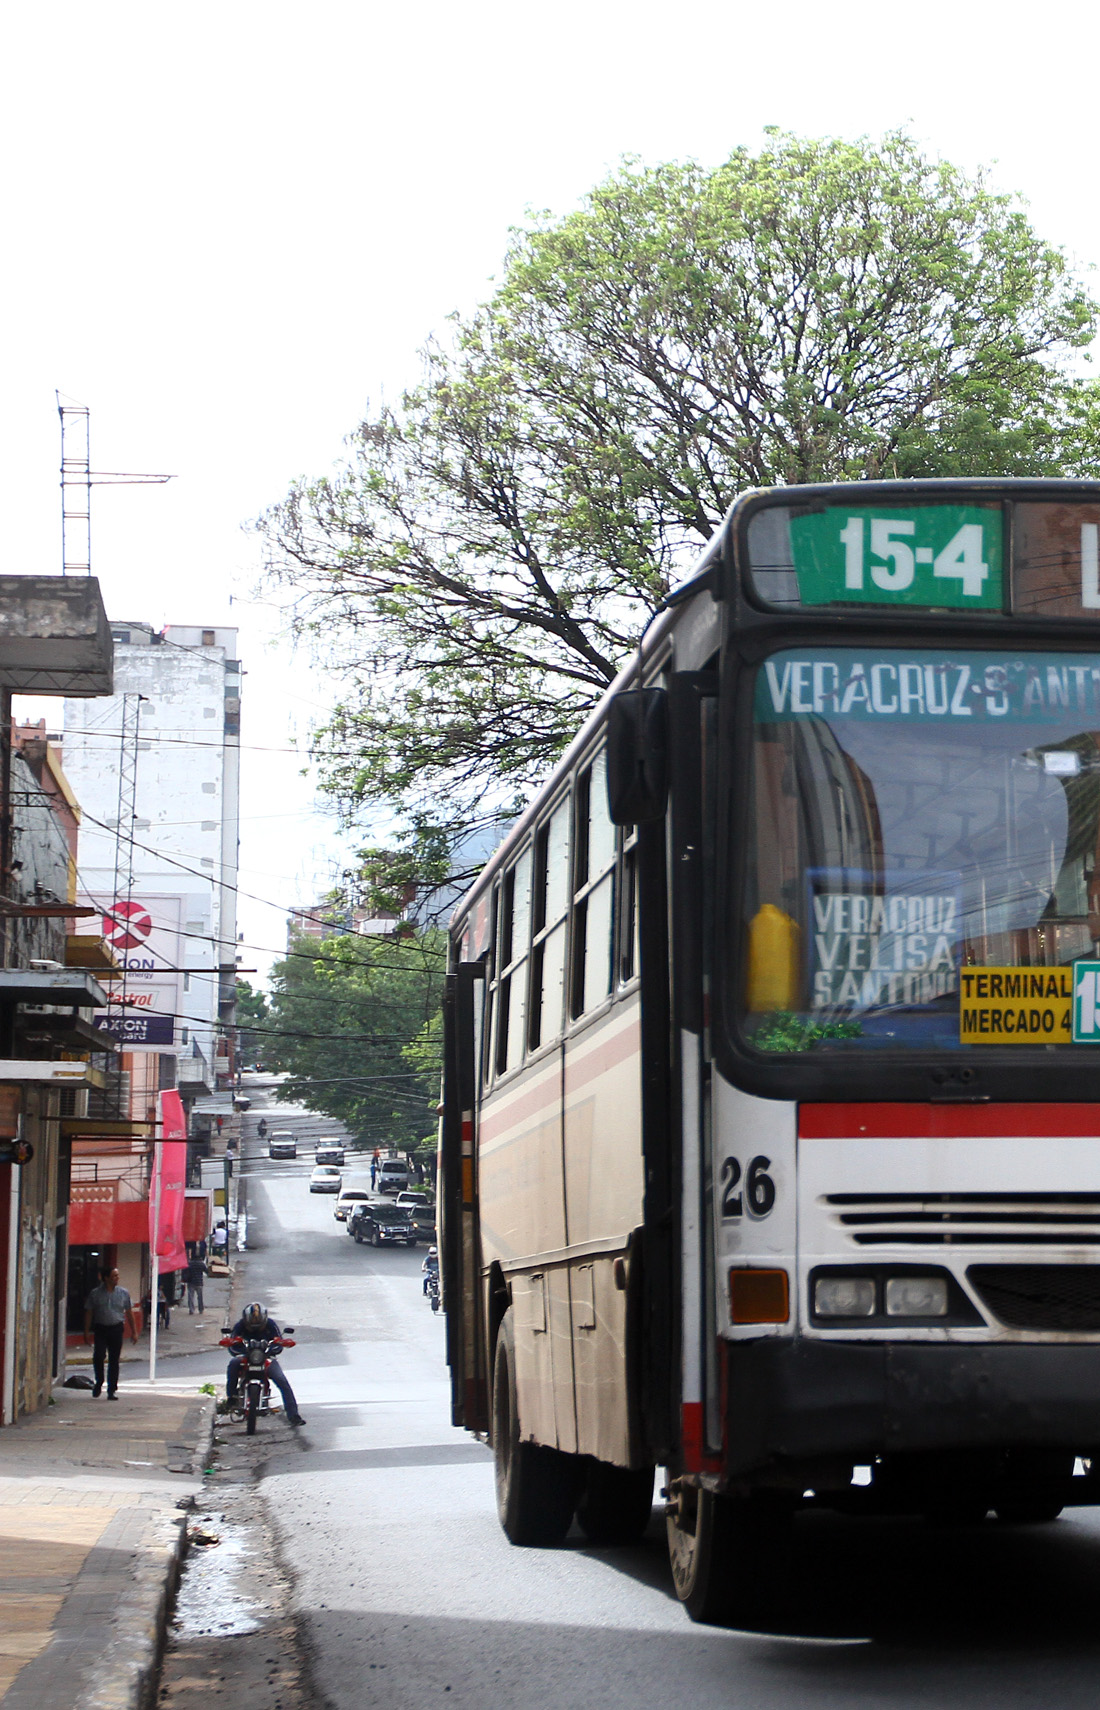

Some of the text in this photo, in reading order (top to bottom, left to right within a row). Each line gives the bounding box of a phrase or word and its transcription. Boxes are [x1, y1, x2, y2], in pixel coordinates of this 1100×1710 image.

[840, 516, 989, 597] 15-4
[813, 895, 957, 933] VERACRUZ
[962, 974, 1071, 999] TERMINAL
[98, 1020, 148, 1031] AXON
[963, 1009, 1071, 1034] MERCADO 4
[721, 1154, 776, 1218] 26
